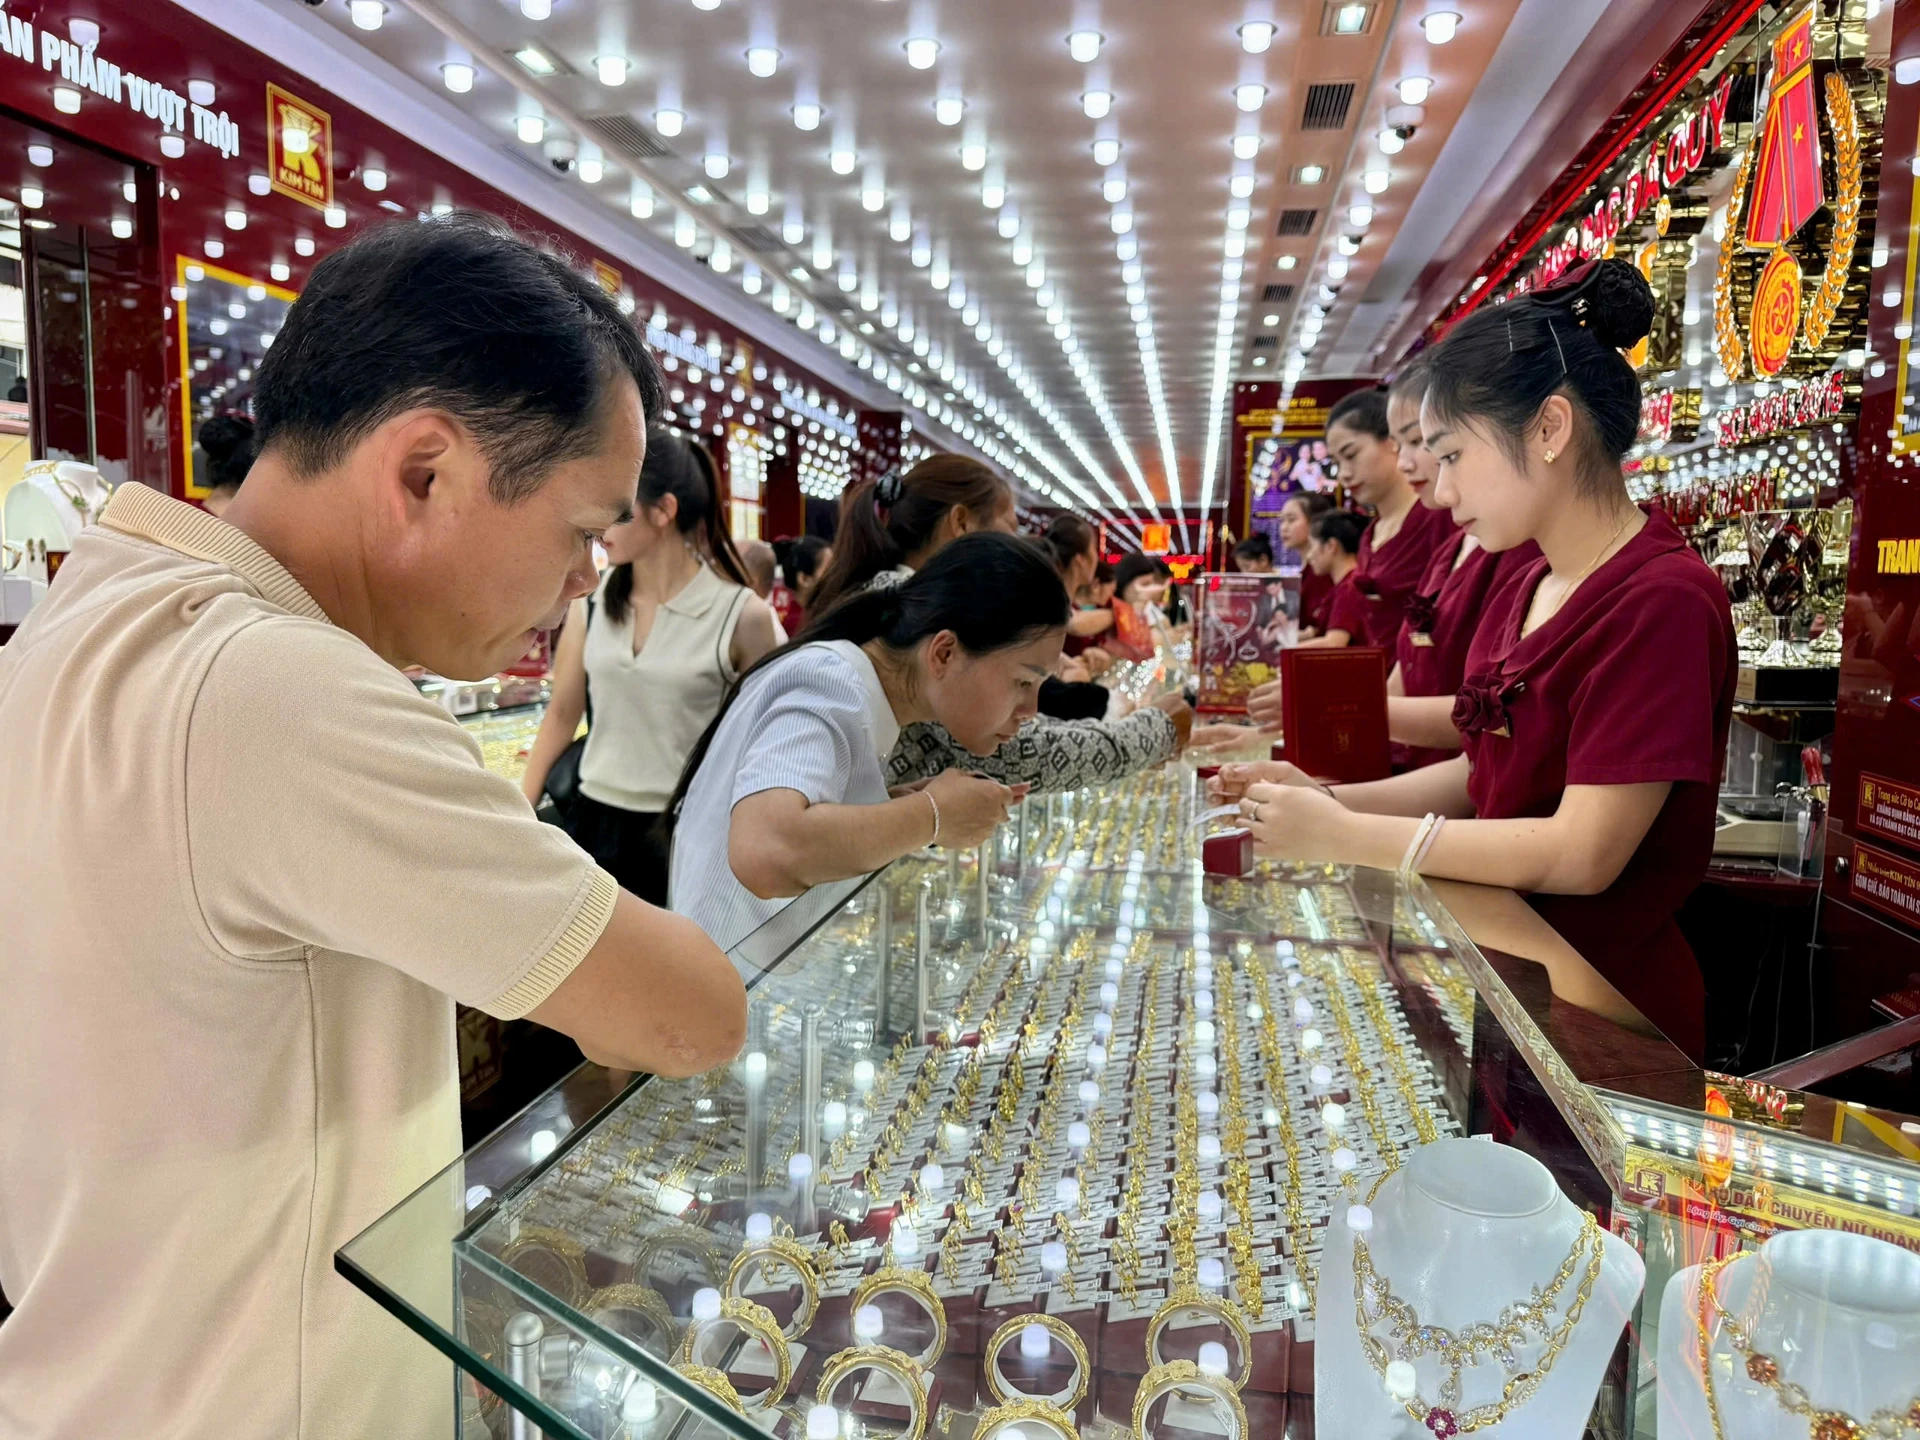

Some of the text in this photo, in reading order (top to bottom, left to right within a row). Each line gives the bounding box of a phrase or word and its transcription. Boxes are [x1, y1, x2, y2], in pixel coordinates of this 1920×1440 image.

[41, 30, 122, 102] PHẨM
[127, 72, 187, 133] VƯỢT
[190, 104, 239, 159] TRỘI
[1664, 73, 1734, 188] QUÝ
[279, 166, 304, 190] KIM
[1889, 870, 1903, 883] KIM
[1768, 1200, 1836, 1230] CHUYỀN
